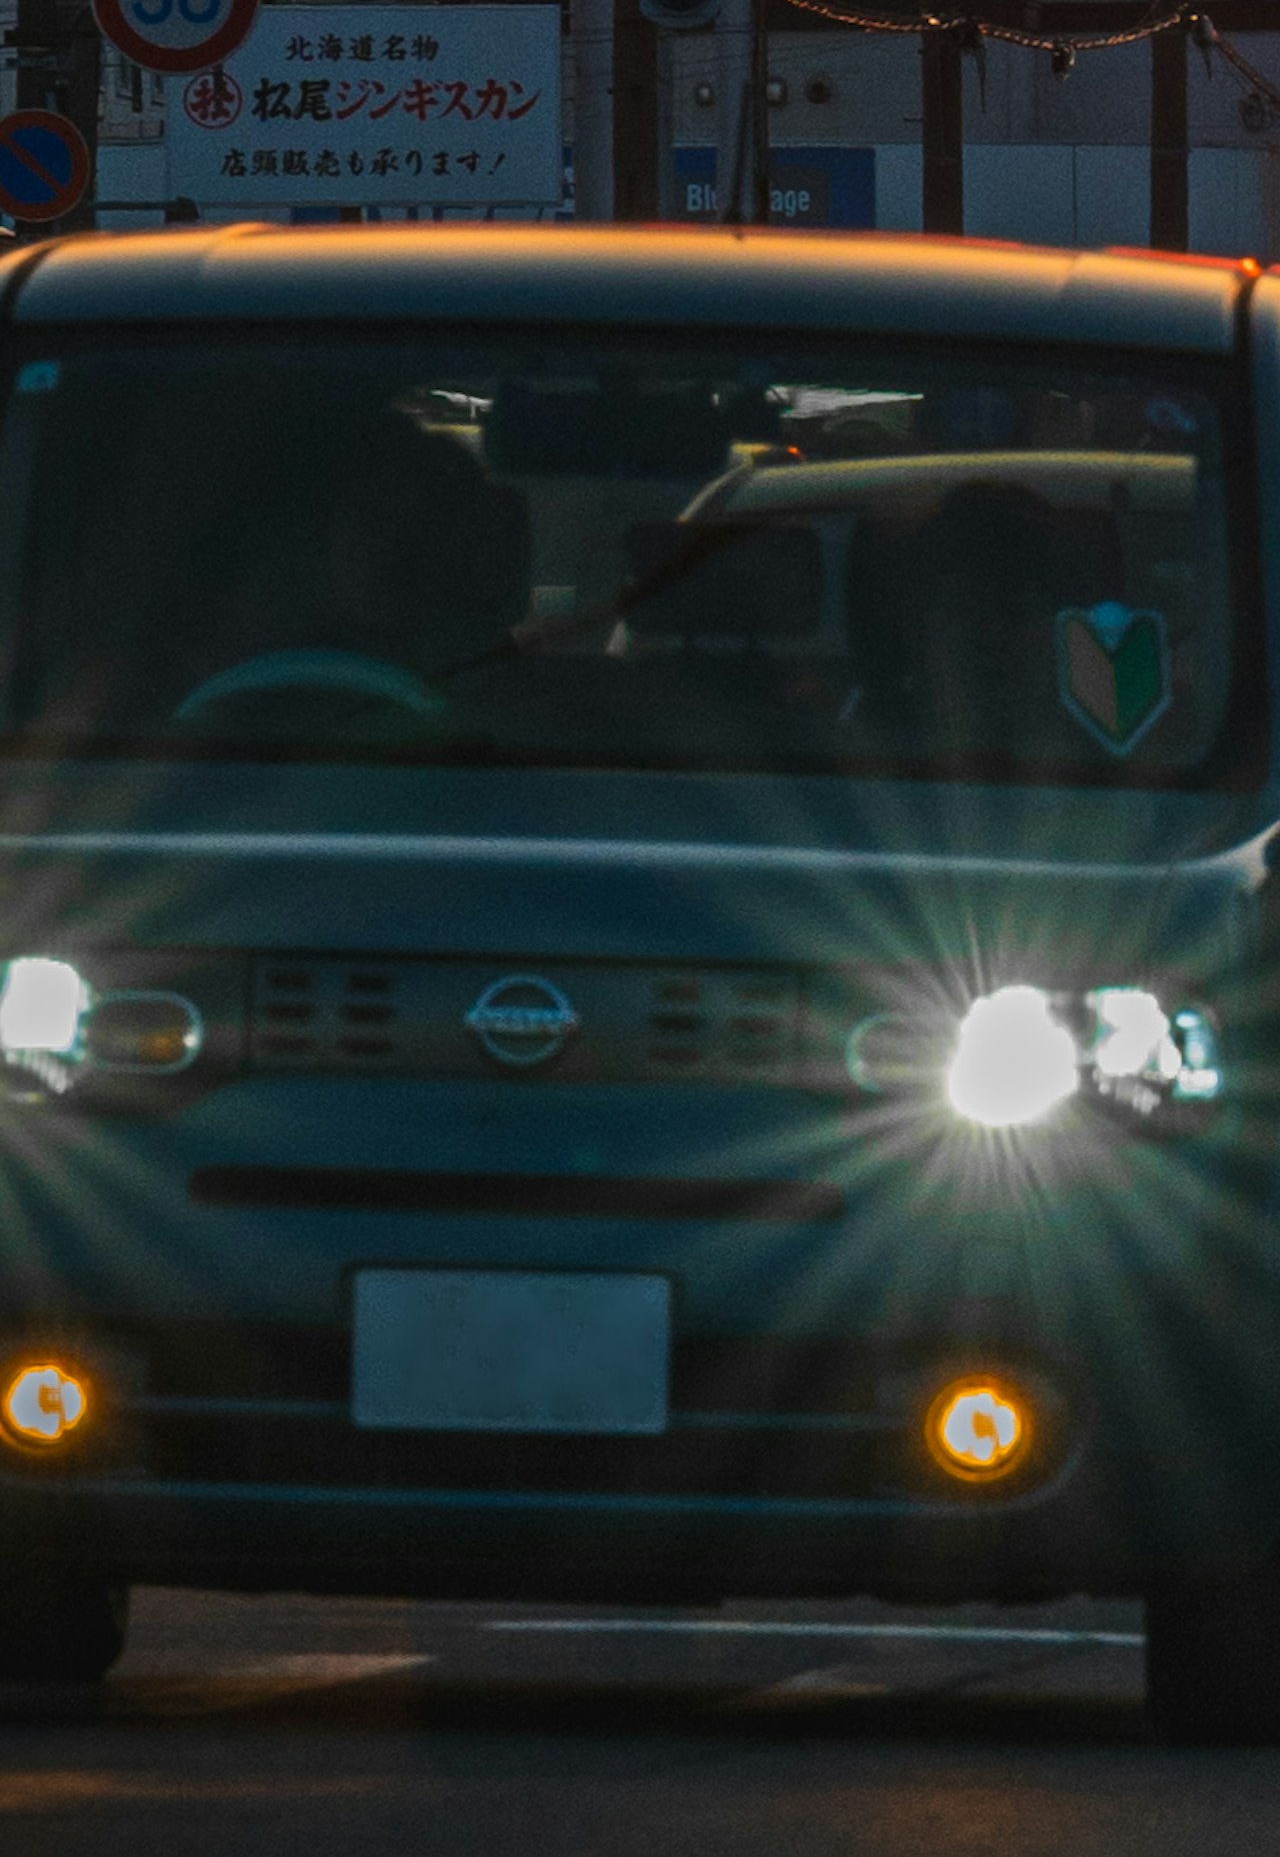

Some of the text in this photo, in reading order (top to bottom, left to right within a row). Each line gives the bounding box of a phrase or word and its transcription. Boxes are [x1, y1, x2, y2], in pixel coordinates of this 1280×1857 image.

[286, 34, 439, 62] 北海道名物
[252, 77, 544, 123] 松尾ジンギスカン
